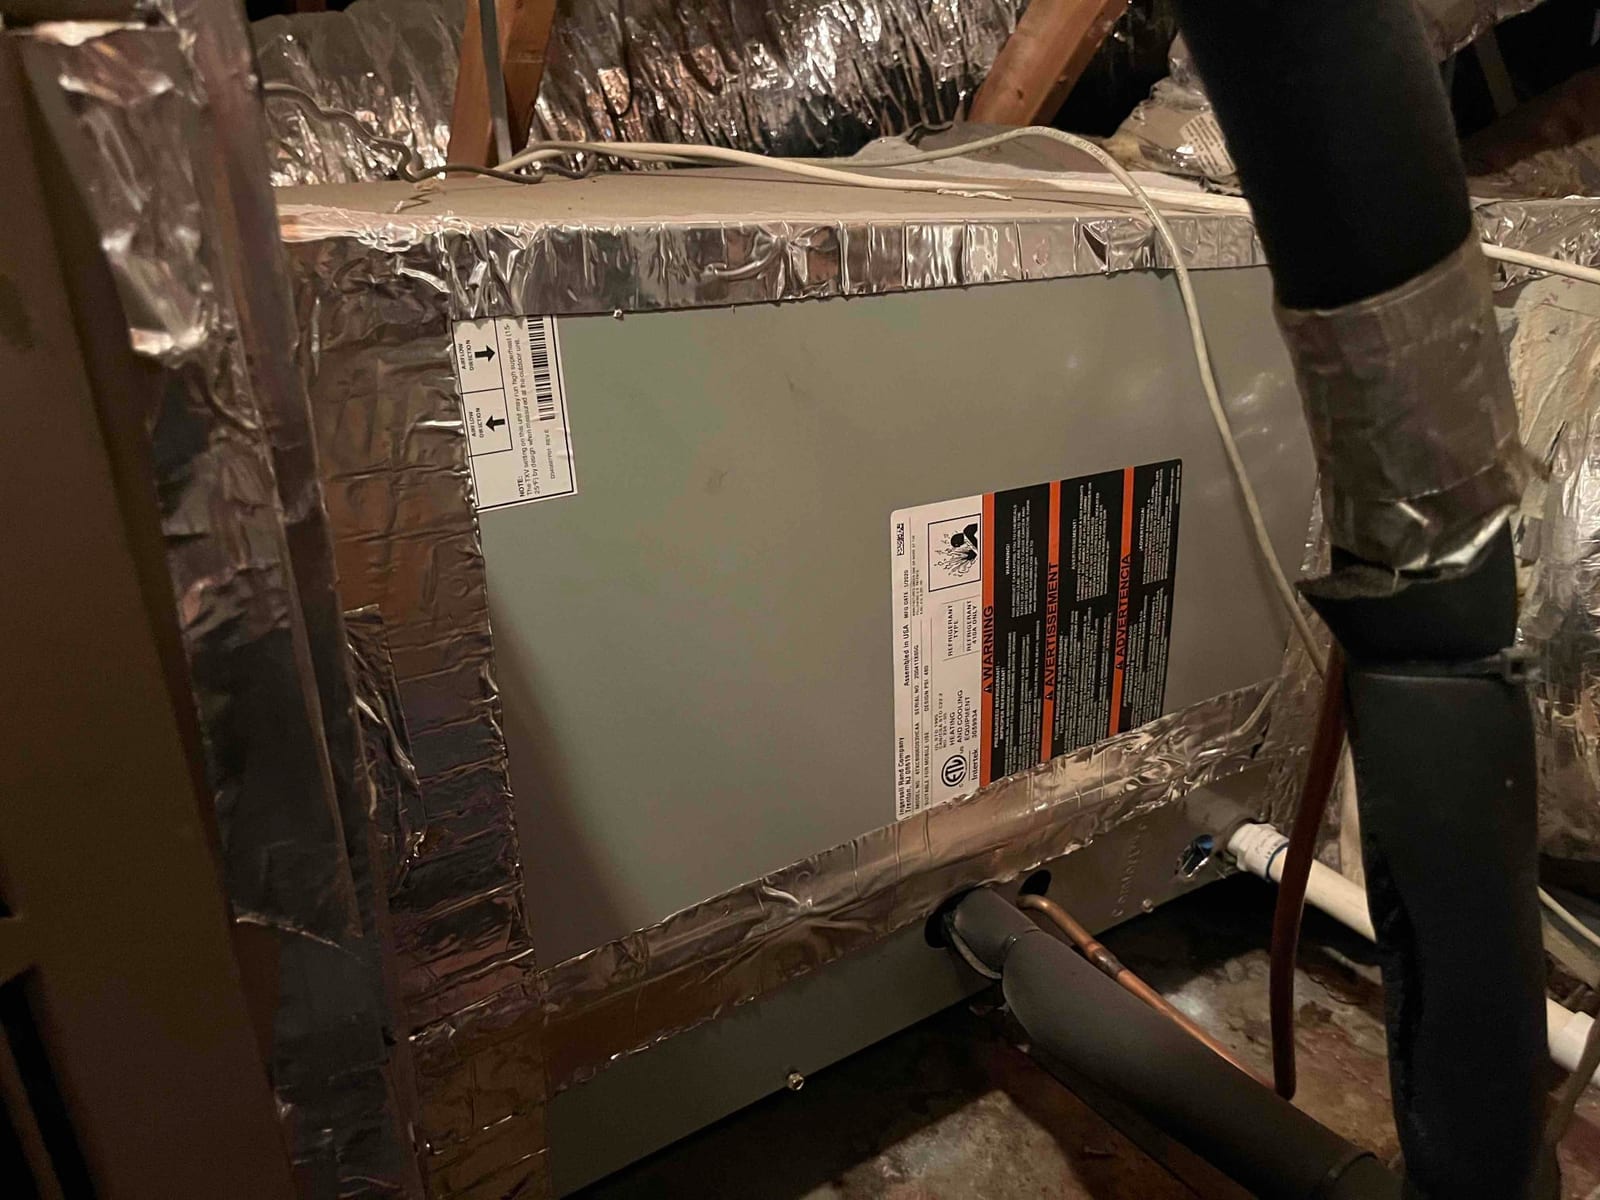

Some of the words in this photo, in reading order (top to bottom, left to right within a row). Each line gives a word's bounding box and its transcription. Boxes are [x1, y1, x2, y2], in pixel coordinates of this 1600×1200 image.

[504, 324, 512, 336] (15-
[507, 338, 516, 369] superheat
[522, 397, 530, 428] measured
[1045, 562, 1058, 686] AVERTISSEMENT
[1116, 554, 1130, 656] ADVERTENCIA
[983, 605, 993, 681] WARNING
